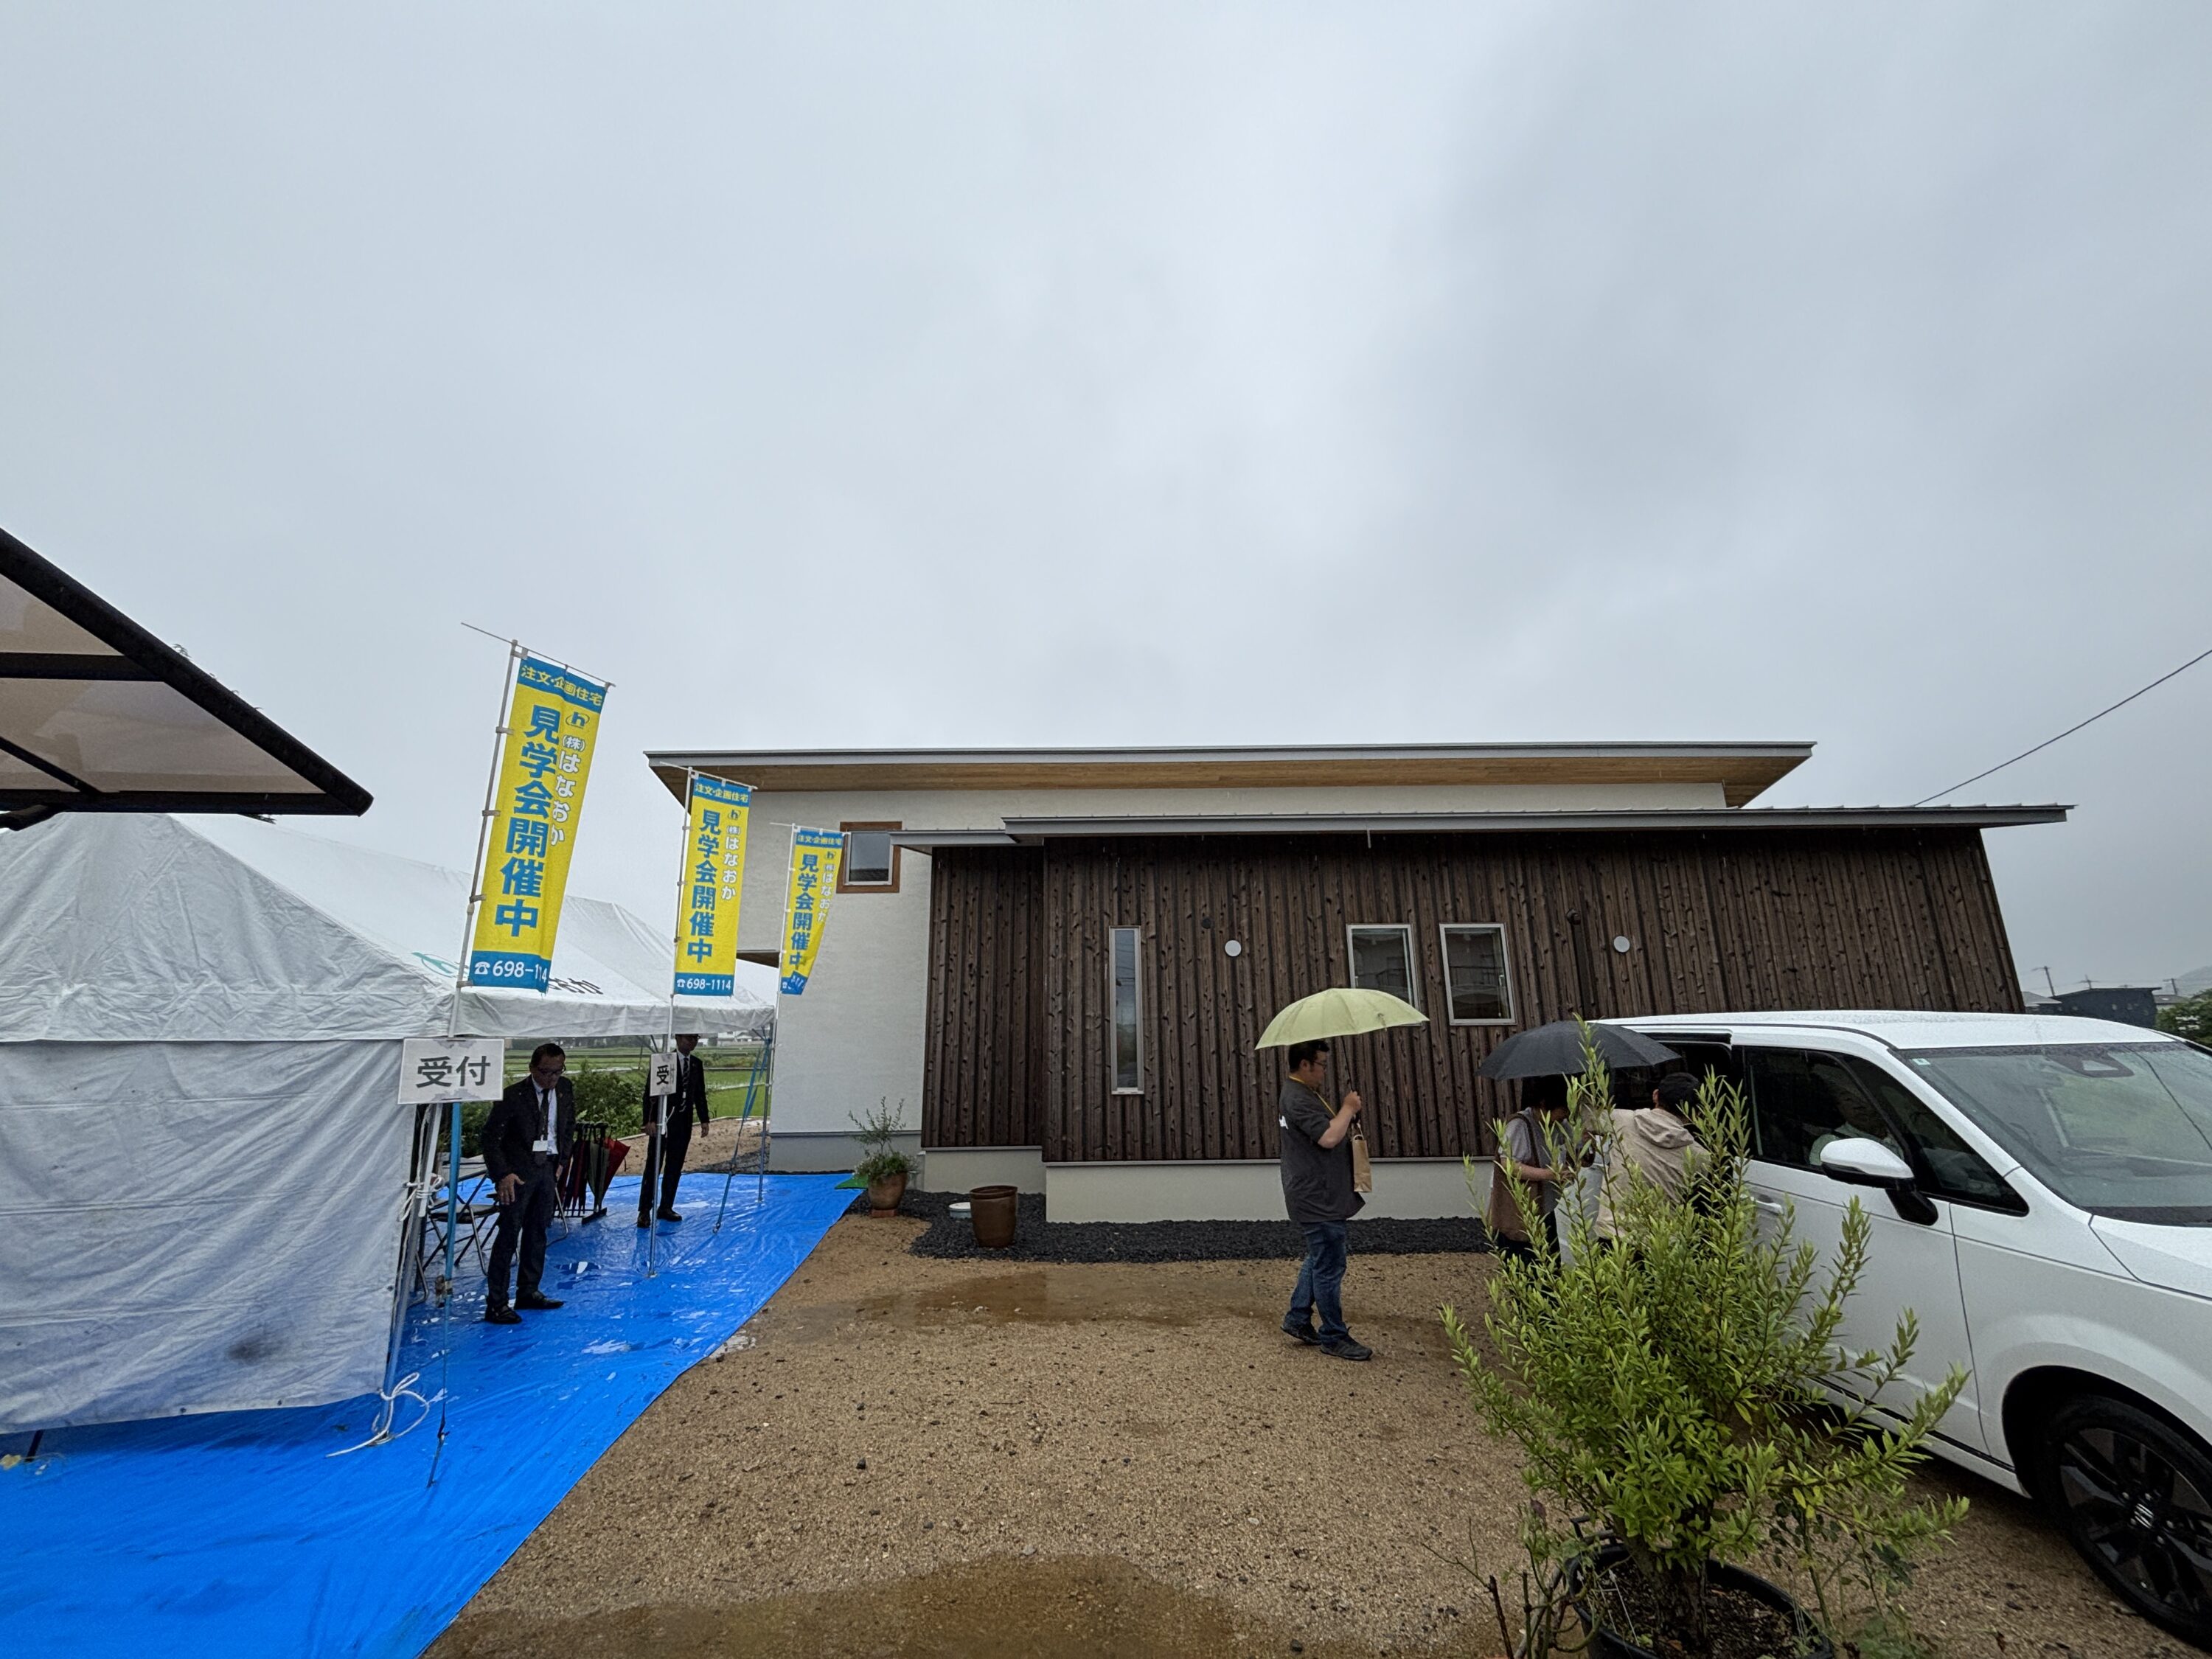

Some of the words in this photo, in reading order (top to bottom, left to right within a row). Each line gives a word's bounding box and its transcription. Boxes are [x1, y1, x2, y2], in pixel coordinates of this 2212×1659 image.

[495, 704, 561, 937] 見学会開催中
[687, 809, 721, 964] 見学会開催中
[686, 978, 731, 990] 698-1114
[415, 1055, 491, 1089] 受付
